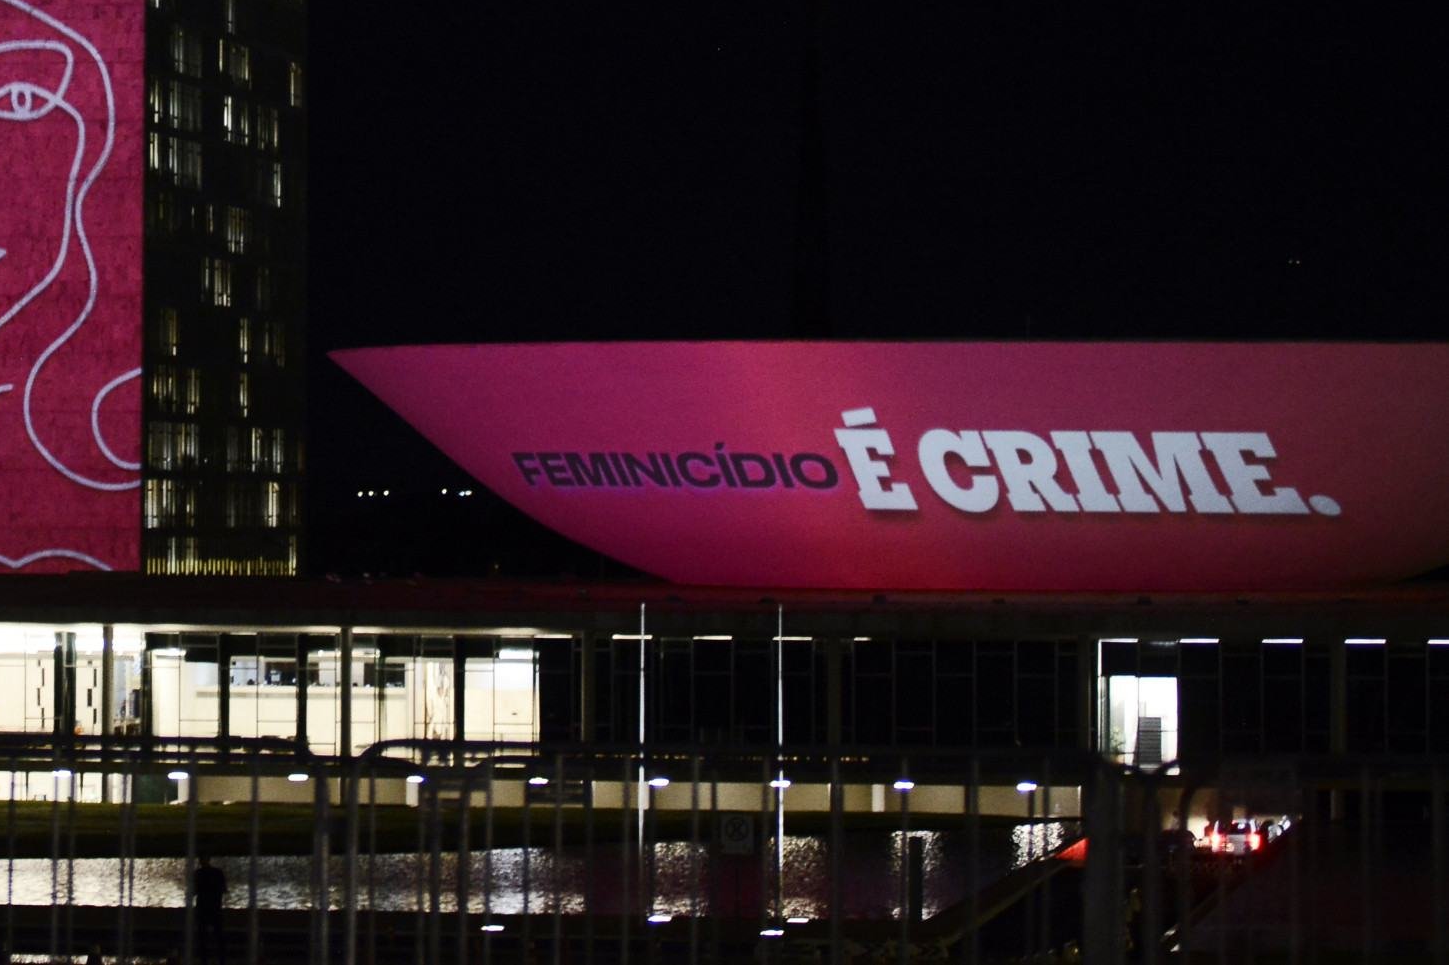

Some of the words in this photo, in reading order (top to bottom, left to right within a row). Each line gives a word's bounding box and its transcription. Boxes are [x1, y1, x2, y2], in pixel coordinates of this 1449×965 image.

[512, 442, 838, 490] FEMINICÍDIO
[834, 407, 918, 510] É
[918, 428, 1342, 517] CRIME.
